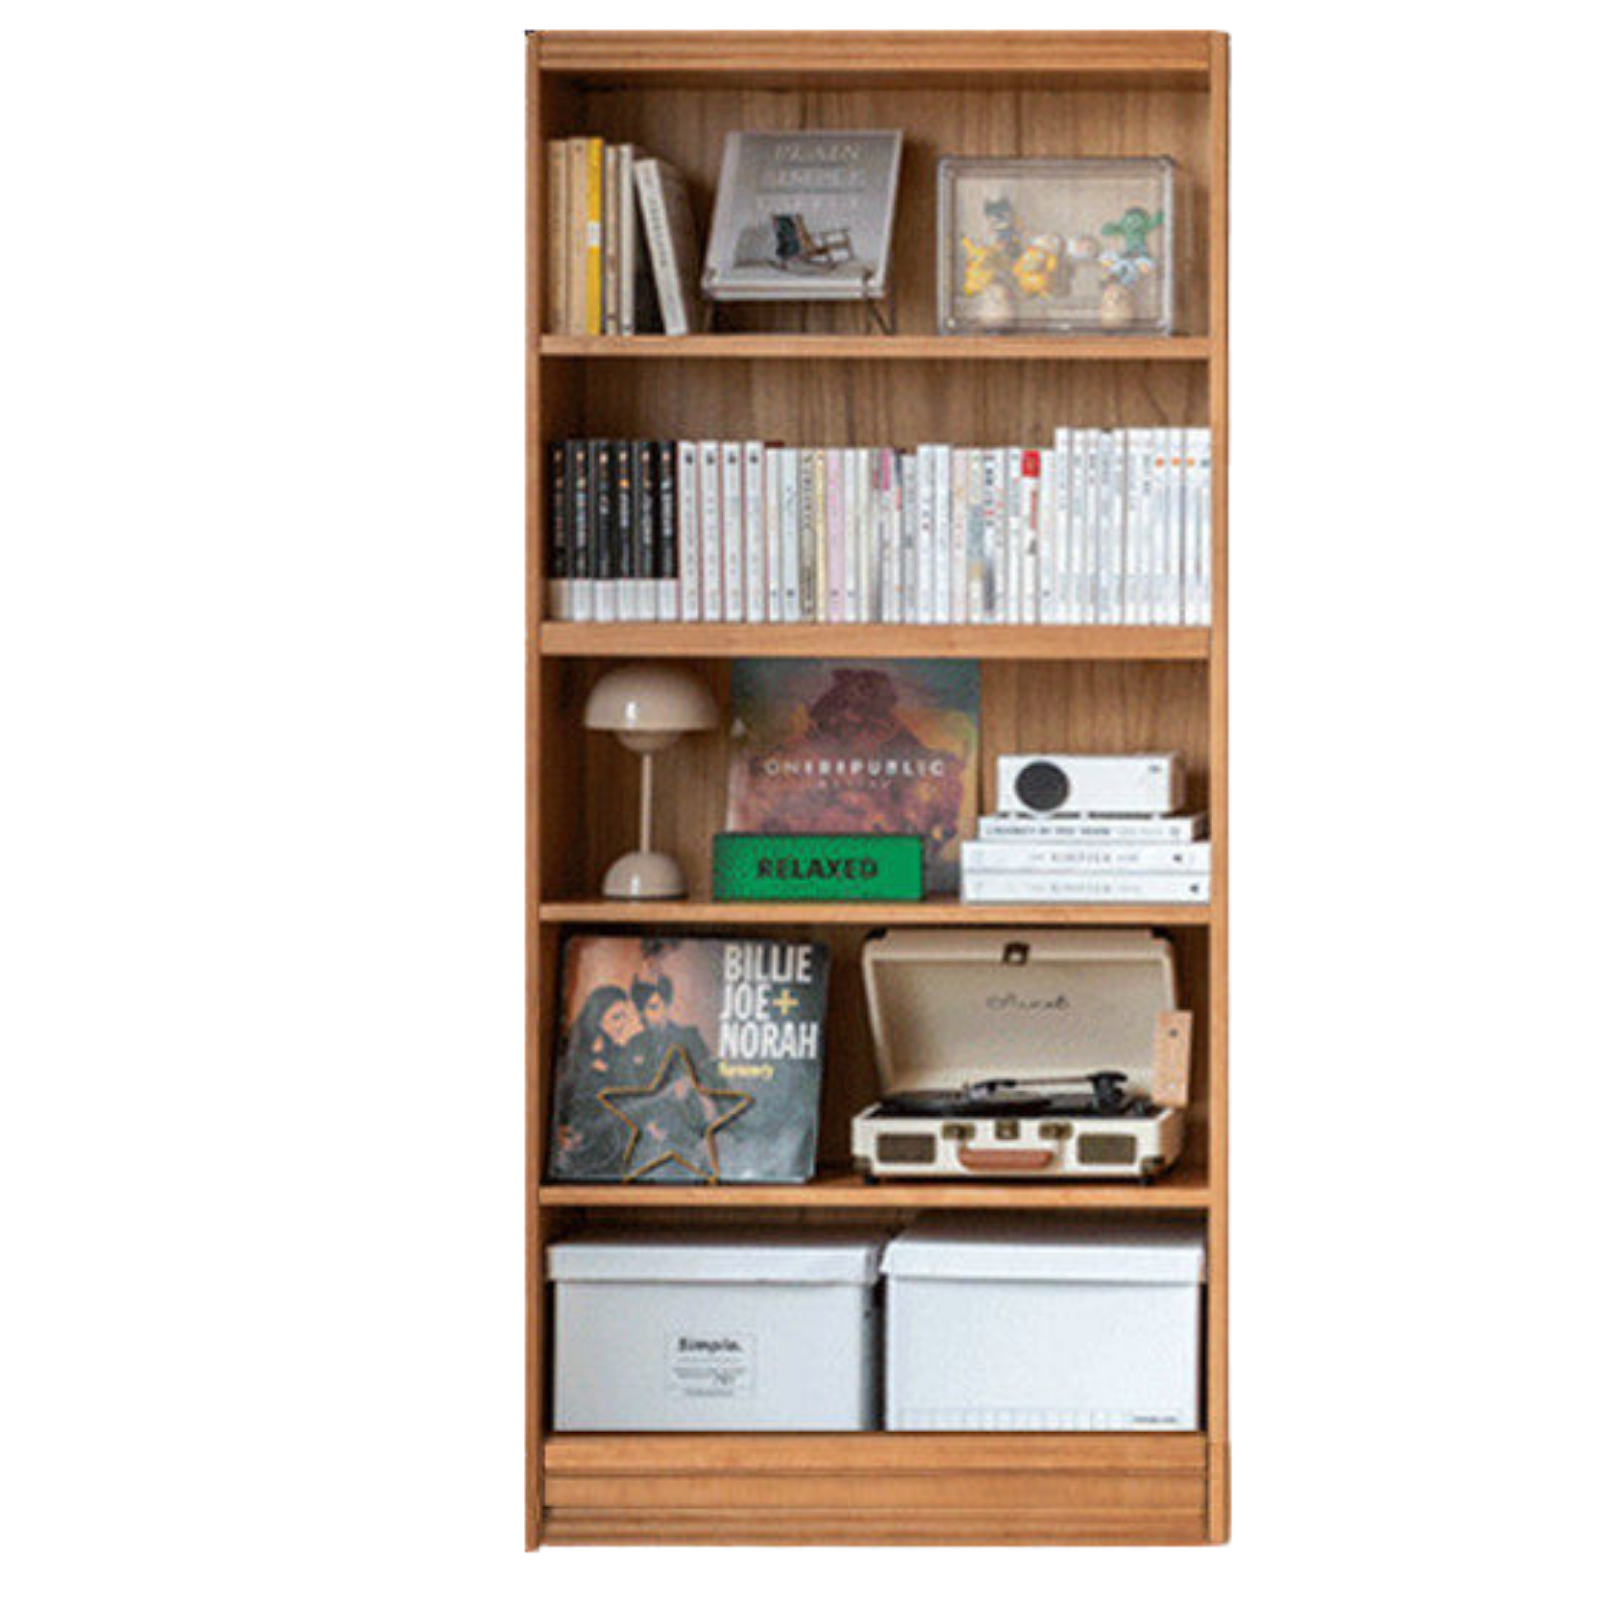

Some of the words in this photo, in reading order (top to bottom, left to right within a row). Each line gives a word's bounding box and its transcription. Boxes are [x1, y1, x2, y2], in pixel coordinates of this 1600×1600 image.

[757, 857, 878, 880] RELAXED
[723, 944, 813, 983] BILLIE
[718, 1020, 819, 1060] NORAH
